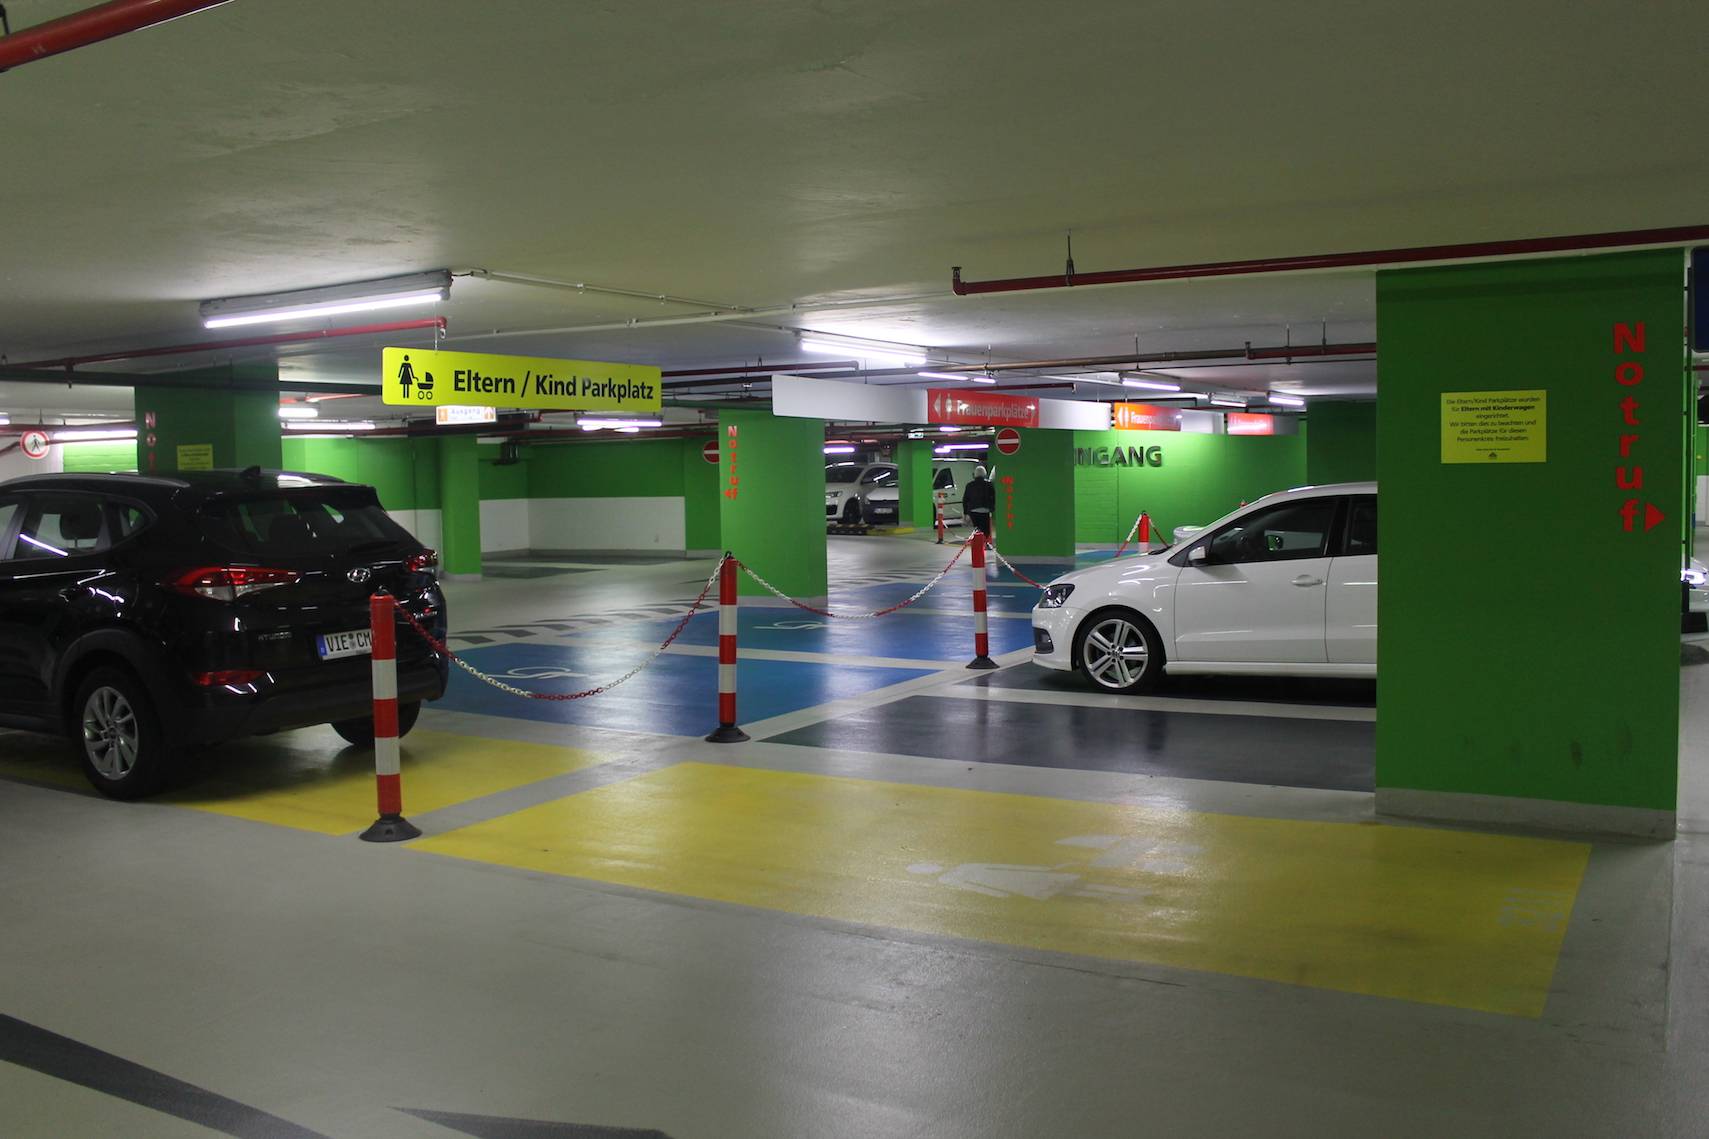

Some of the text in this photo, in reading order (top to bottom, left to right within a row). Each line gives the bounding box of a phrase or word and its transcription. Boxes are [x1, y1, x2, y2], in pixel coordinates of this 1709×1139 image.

[453, 369, 654, 404] Eltern / Kind Parkplatz
[1612, 321, 1646, 532] Notruf
[726, 425, 740, 500] Notruf
[326, 634, 349, 652] VIE
